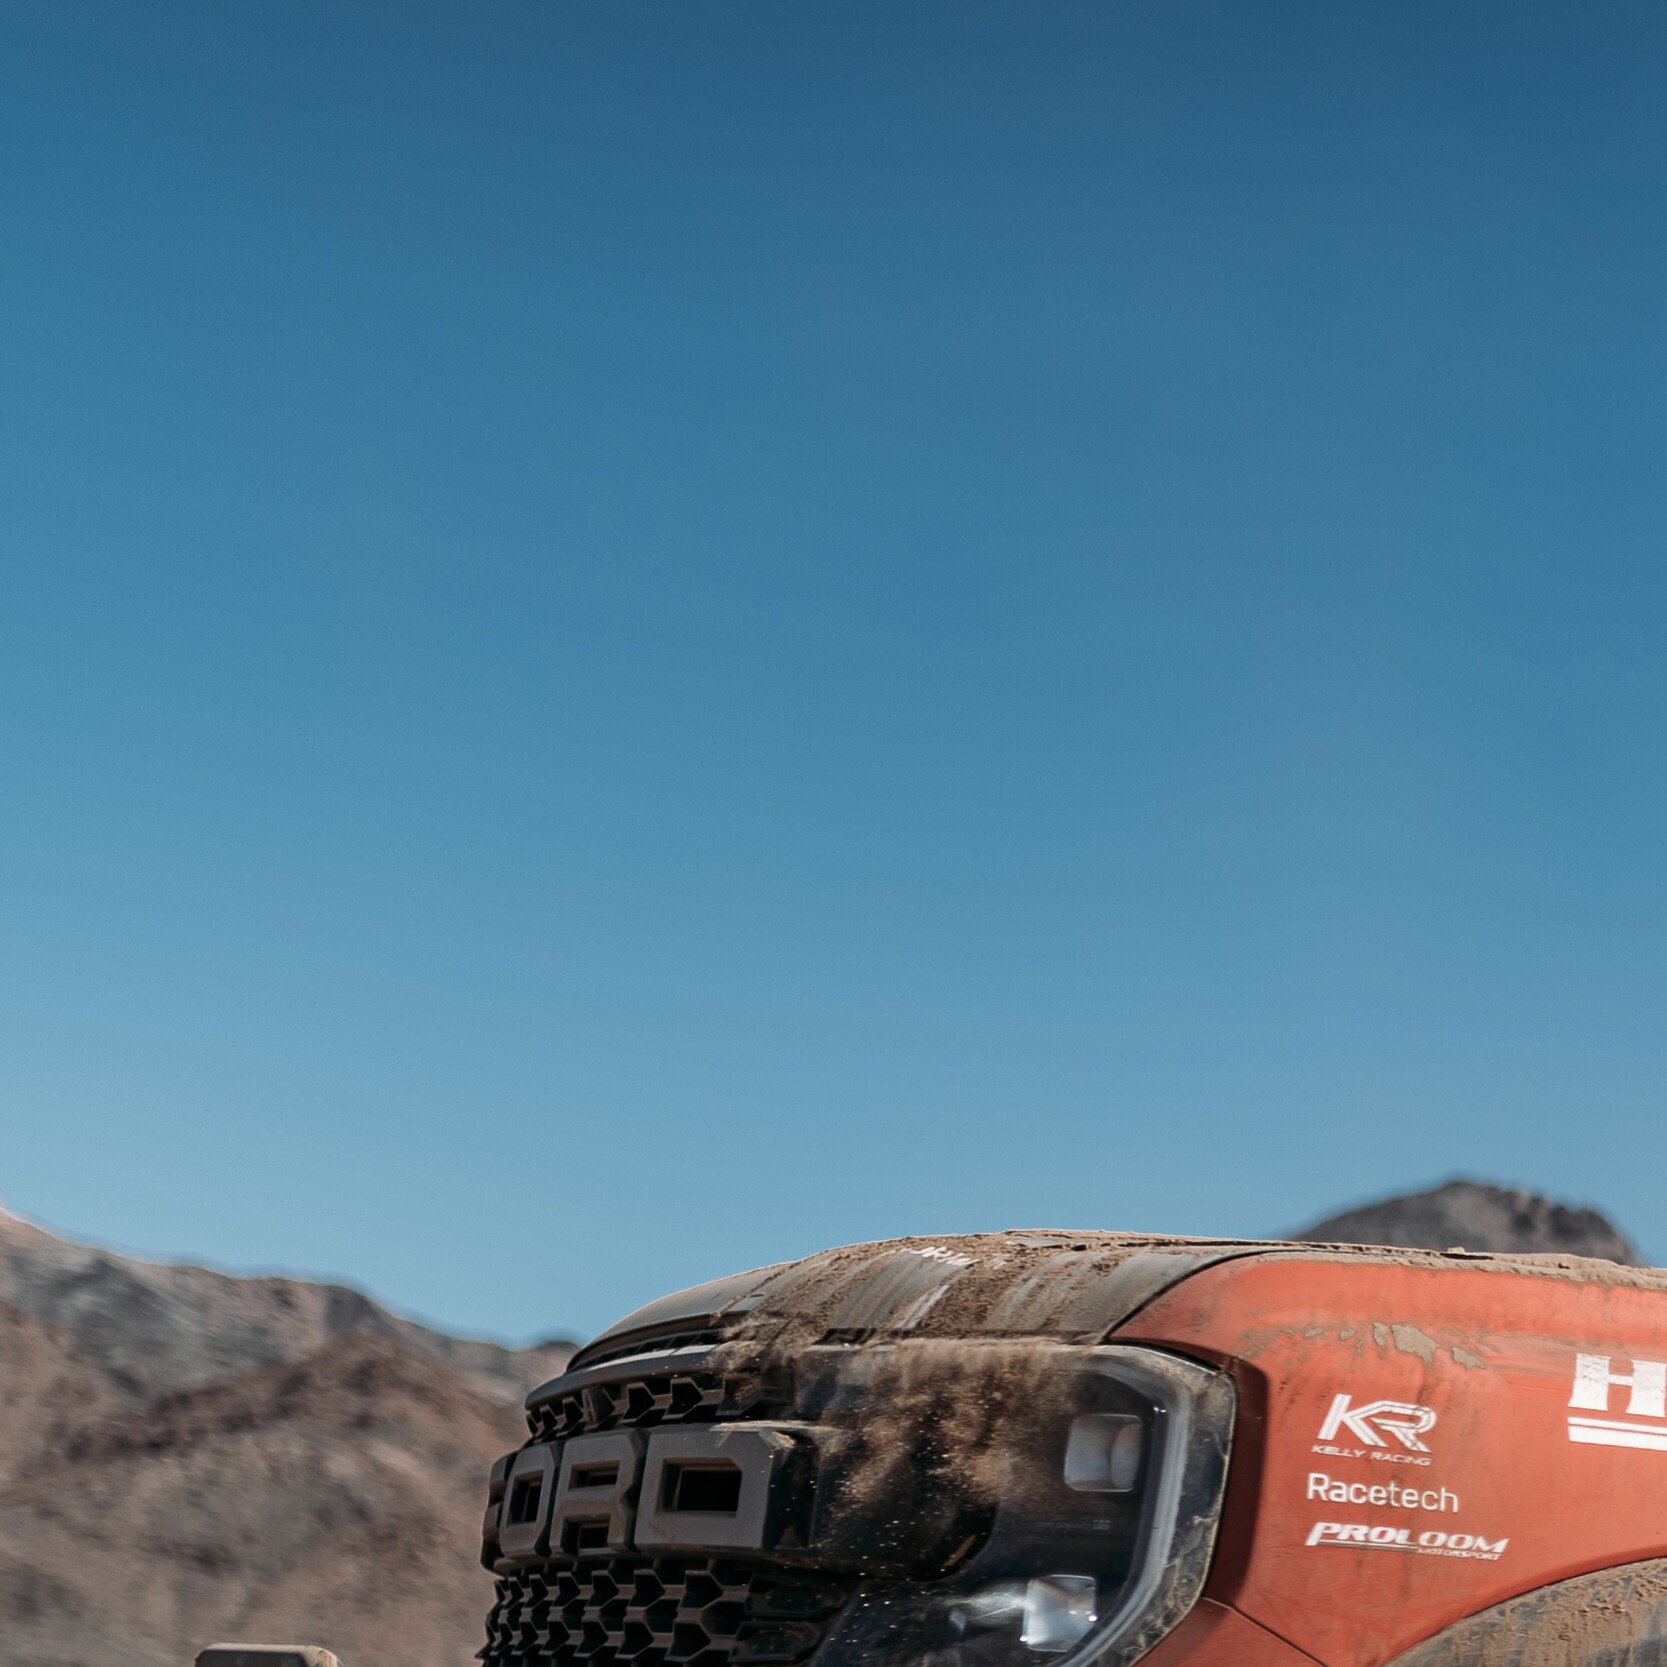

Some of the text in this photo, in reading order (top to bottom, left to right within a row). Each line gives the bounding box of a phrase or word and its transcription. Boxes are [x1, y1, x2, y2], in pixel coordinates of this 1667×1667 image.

[1316, 1393, 1438, 1453] KR
[1311, 1444, 1432, 1466] KELLY RACING
[1306, 1472, 1459, 1513] Racetech
[1304, 1522, 1510, 1554] PROLOOM
[1416, 1547, 1502, 1562] MOTORSPORT
